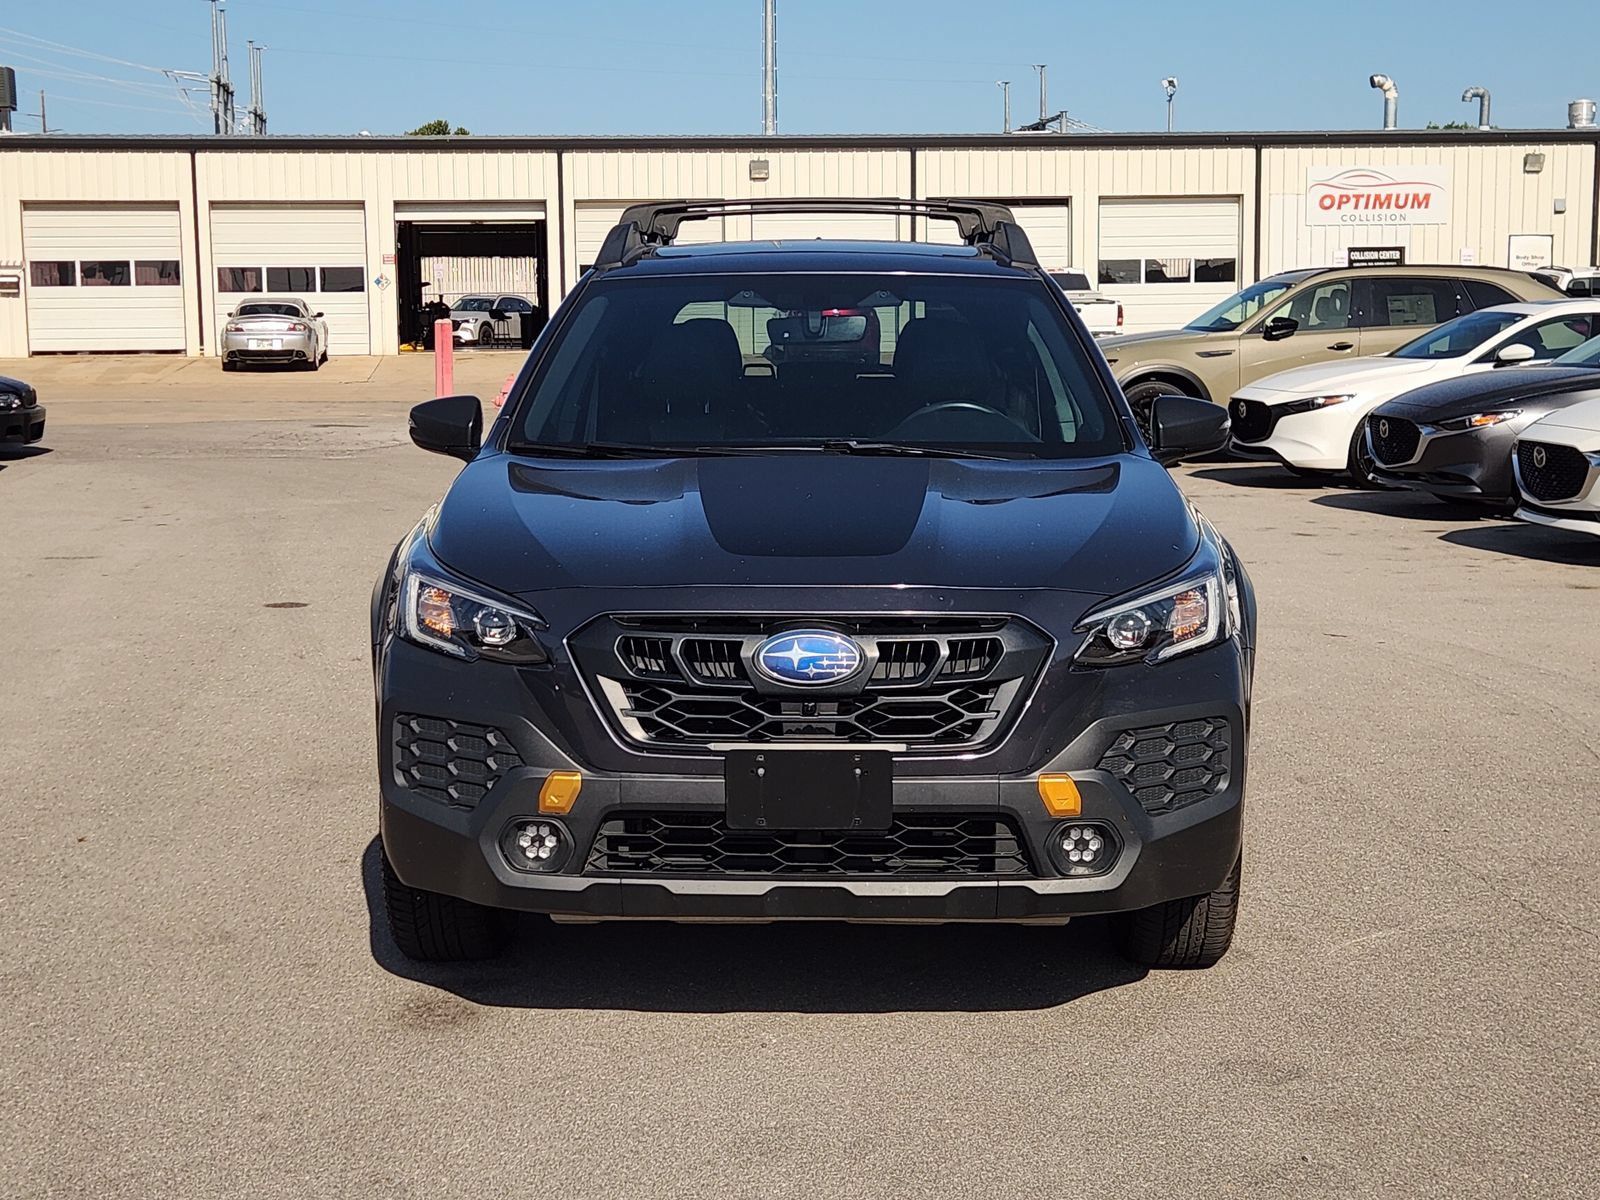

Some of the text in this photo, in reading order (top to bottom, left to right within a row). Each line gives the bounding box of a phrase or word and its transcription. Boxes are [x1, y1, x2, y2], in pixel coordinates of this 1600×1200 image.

[1318, 193, 1432, 211] OPTIMUM
[1340, 213, 1407, 222] COLLISION
[1350, 250, 1379, 260] COLLISION
[1379, 250, 1401, 260] CENTER
